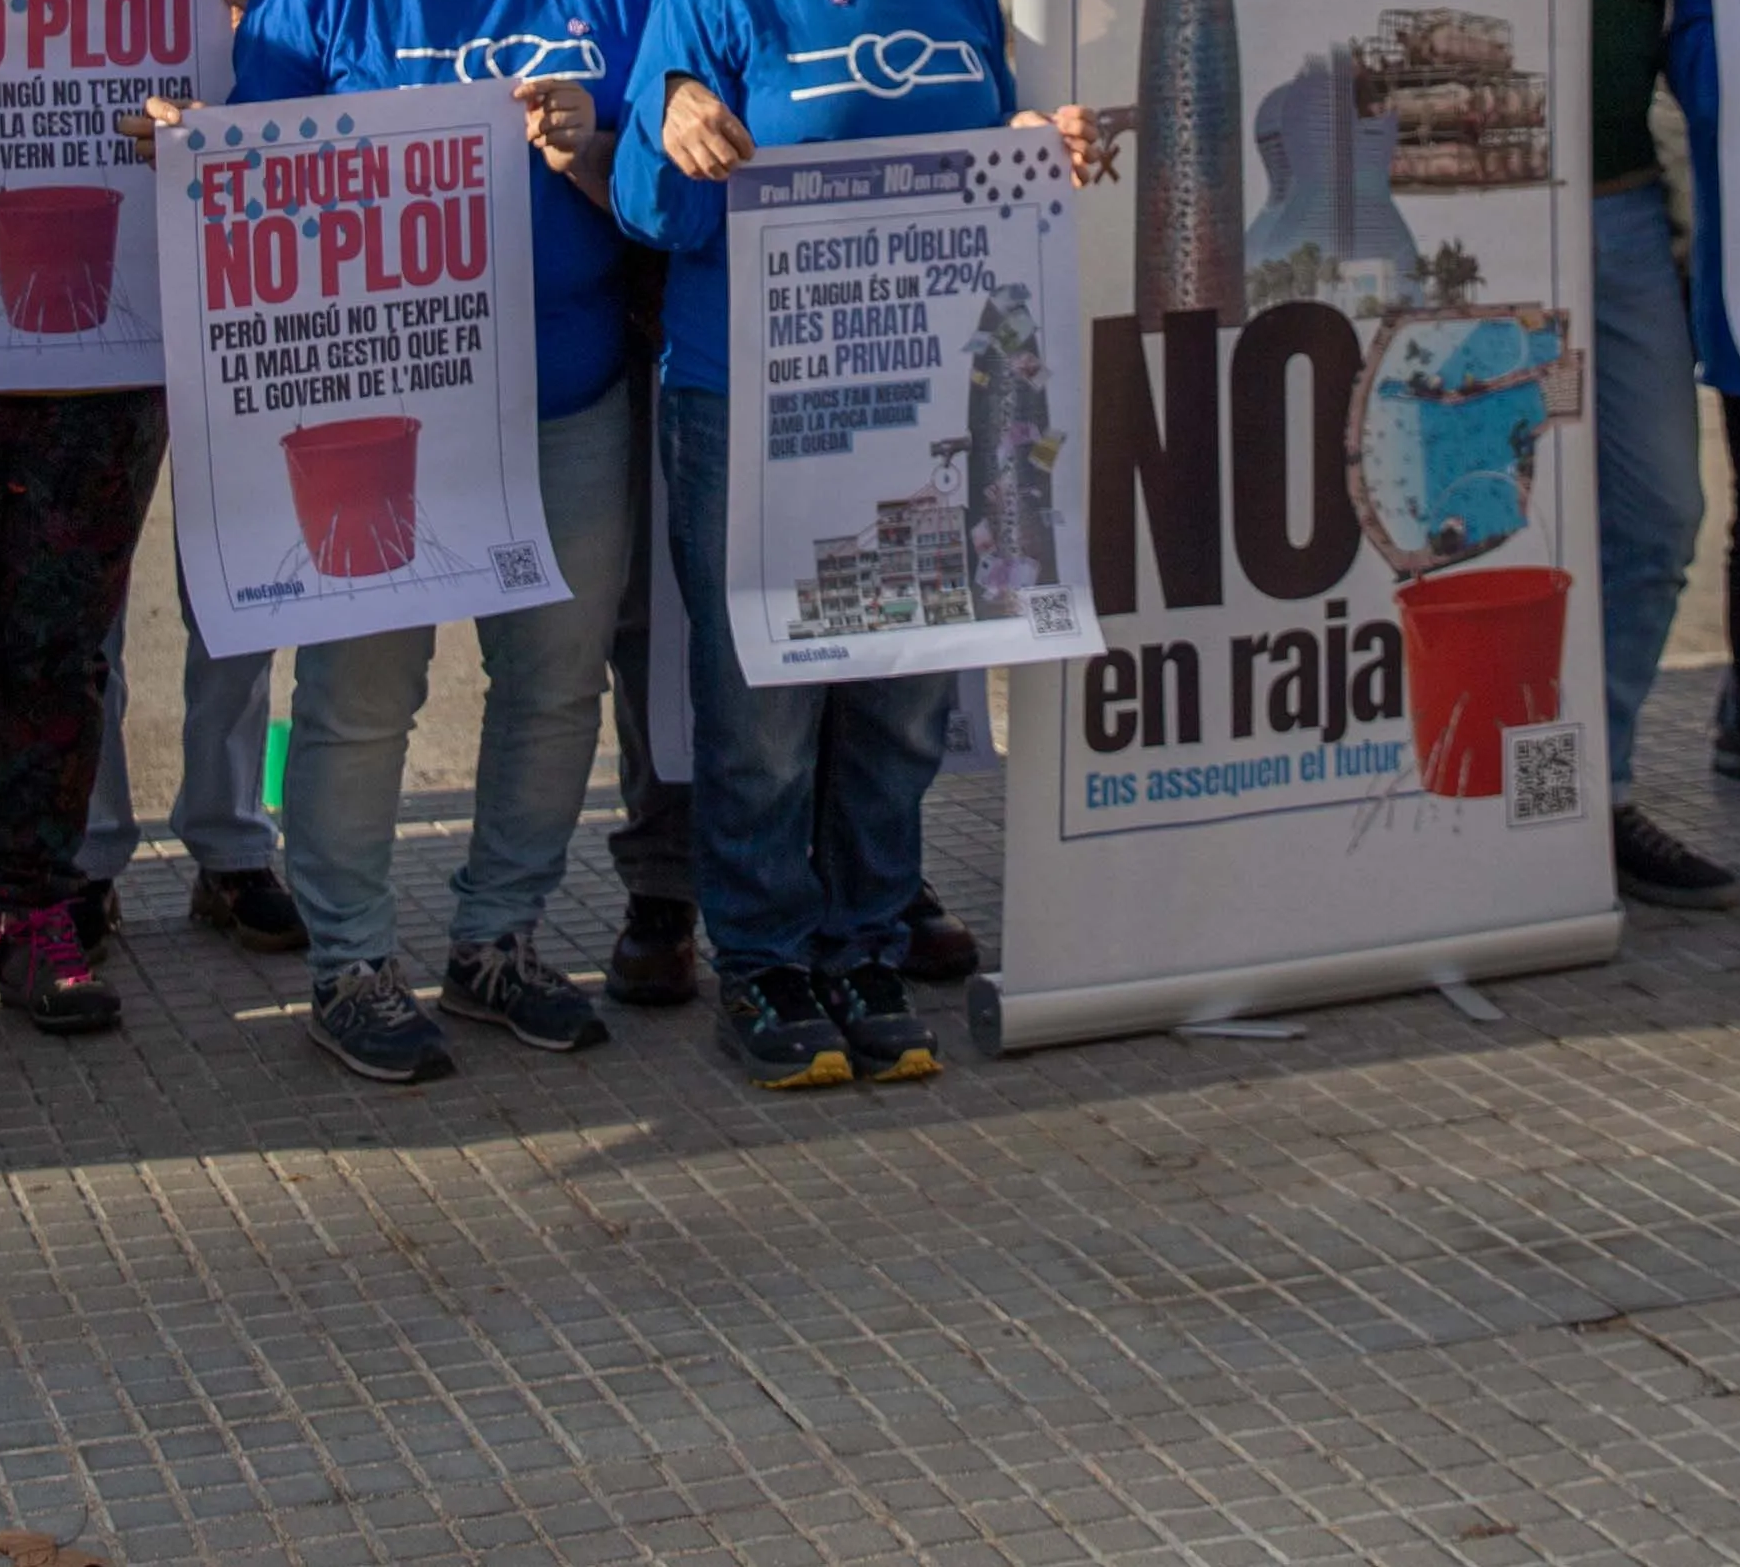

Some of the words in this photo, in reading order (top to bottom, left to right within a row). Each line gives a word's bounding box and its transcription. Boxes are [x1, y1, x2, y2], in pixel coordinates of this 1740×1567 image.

[55, 79, 84, 106] NO
[31, 104, 108, 139] GESTIÓ
[61, 139, 93, 168] DE
[201, 162, 248, 216] ET
[263, 146, 389, 210] DIUEN
[404, 136, 485, 190] QUE
[204, 217, 298, 311] NO
[318, 194, 489, 298] PLOU
[768, 251, 790, 276] LA
[796, 232, 879, 272] GESTIÓ
[888, 224, 990, 266] PÚBLICA
[769, 288, 790, 312] DE
[795, 282, 864, 309] L'AIGUA
[869, 273, 891, 302] ÉS
[896, 277, 920, 299] UN
[926, 264, 996, 297] 22%
[210, 314, 268, 351] PERÒ
[274, 305, 342, 346] NINGÚ
[348, 304, 377, 334] NO
[384, 292, 490, 332] T'EXPLICA
[769, 306, 825, 347] MÉS
[832, 302, 928, 342] BARATA
[221, 356, 248, 383] LA
[255, 346, 319, 377] MALA
[327, 332, 401, 369] GESTIÓ
[408, 333, 451, 362] QUE
[455, 327, 482, 353] FA
[769, 356, 803, 385] QUE
[806, 353, 829, 381] LA
[835, 337, 941, 377] PRIVADA
[233, 385, 259, 415] EL
[265, 374, 352, 411] GOVERN
[358, 370, 386, 398] DE
[392, 358, 474, 395] L'AIGUA
[1088, 300, 1360, 615] NO
[1084, 640, 1200, 754] en
[1231, 599, 1403, 743] raja
[1087, 766, 1137, 810] Ens
[1147, 755, 1291, 803] assequen
[1300, 749, 1325, 783] el
[1334, 742, 1404, 776] futur
